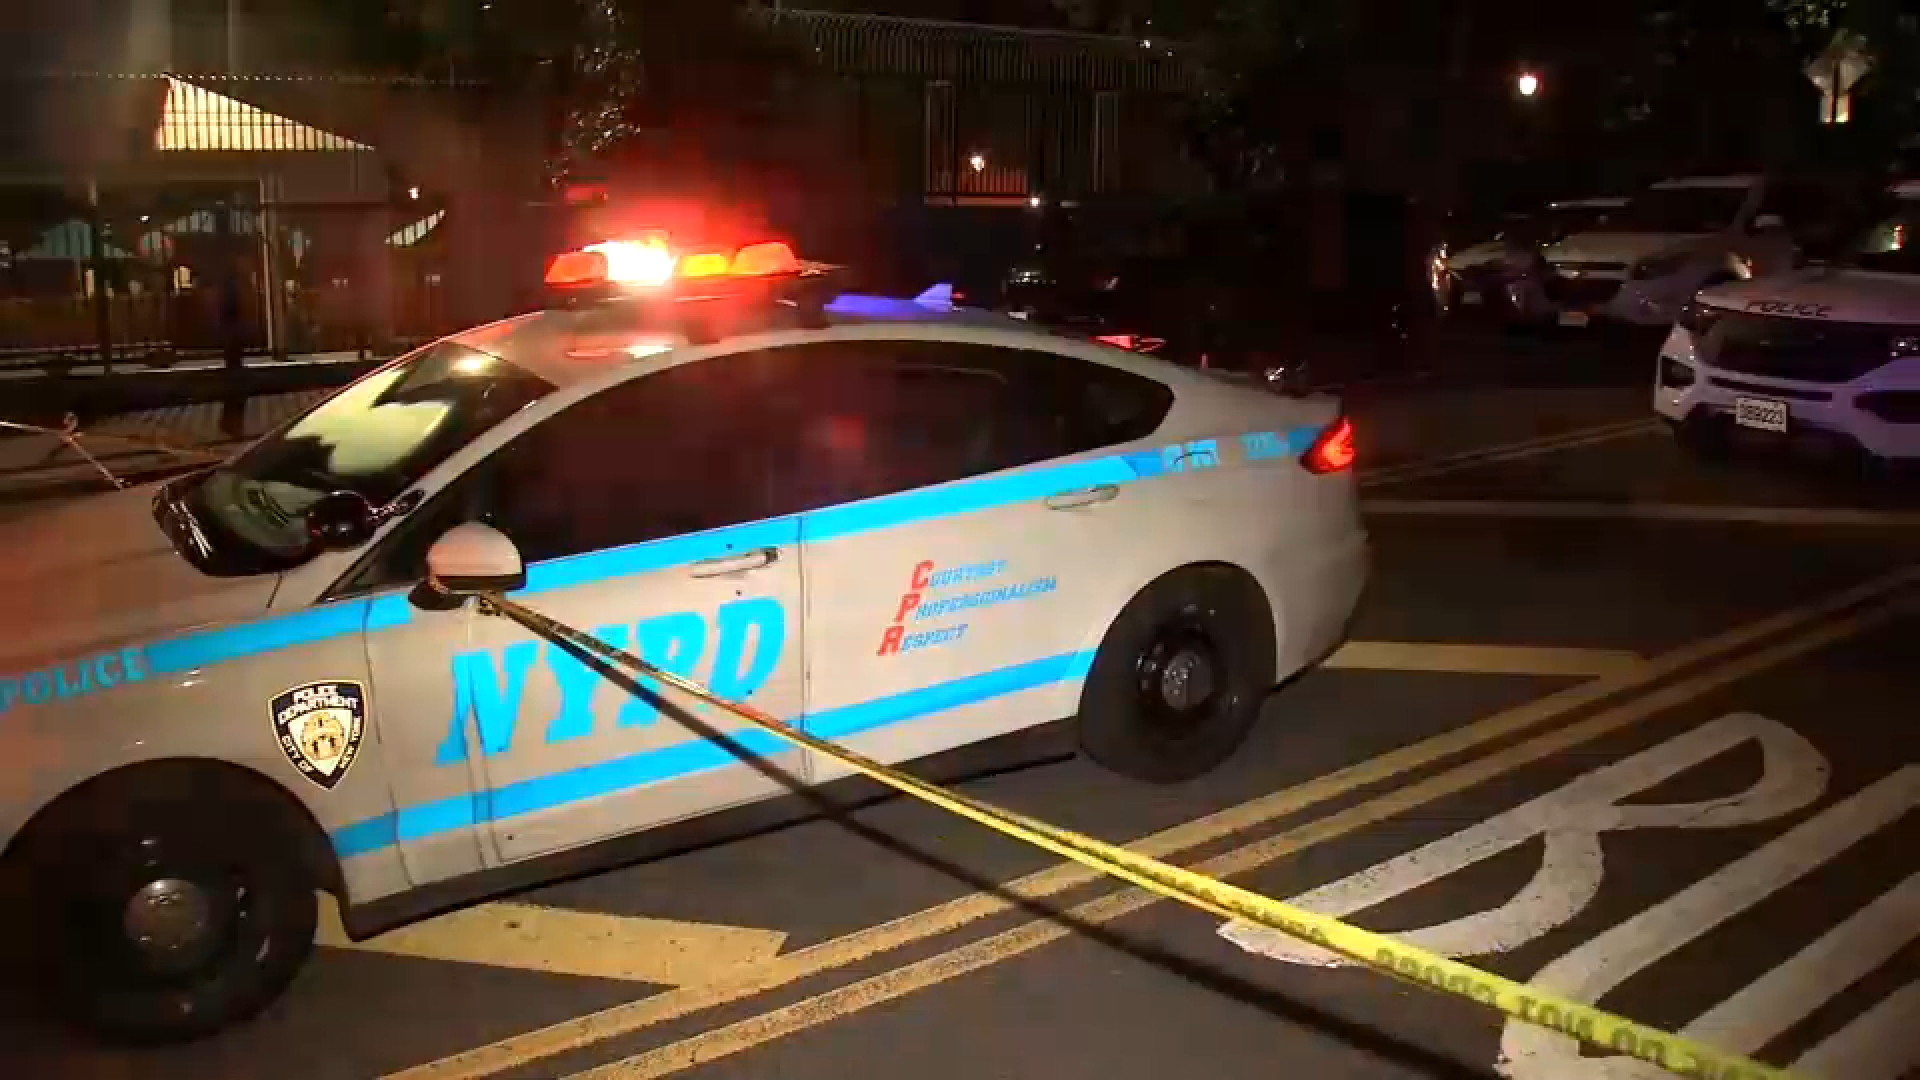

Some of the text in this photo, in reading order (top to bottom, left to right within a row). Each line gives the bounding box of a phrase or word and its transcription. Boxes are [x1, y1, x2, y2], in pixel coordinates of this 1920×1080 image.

[1746, 300, 1832, 318] POLICE
[0, 647, 145, 713] POLICE
[434, 597, 785, 766] NYPD
